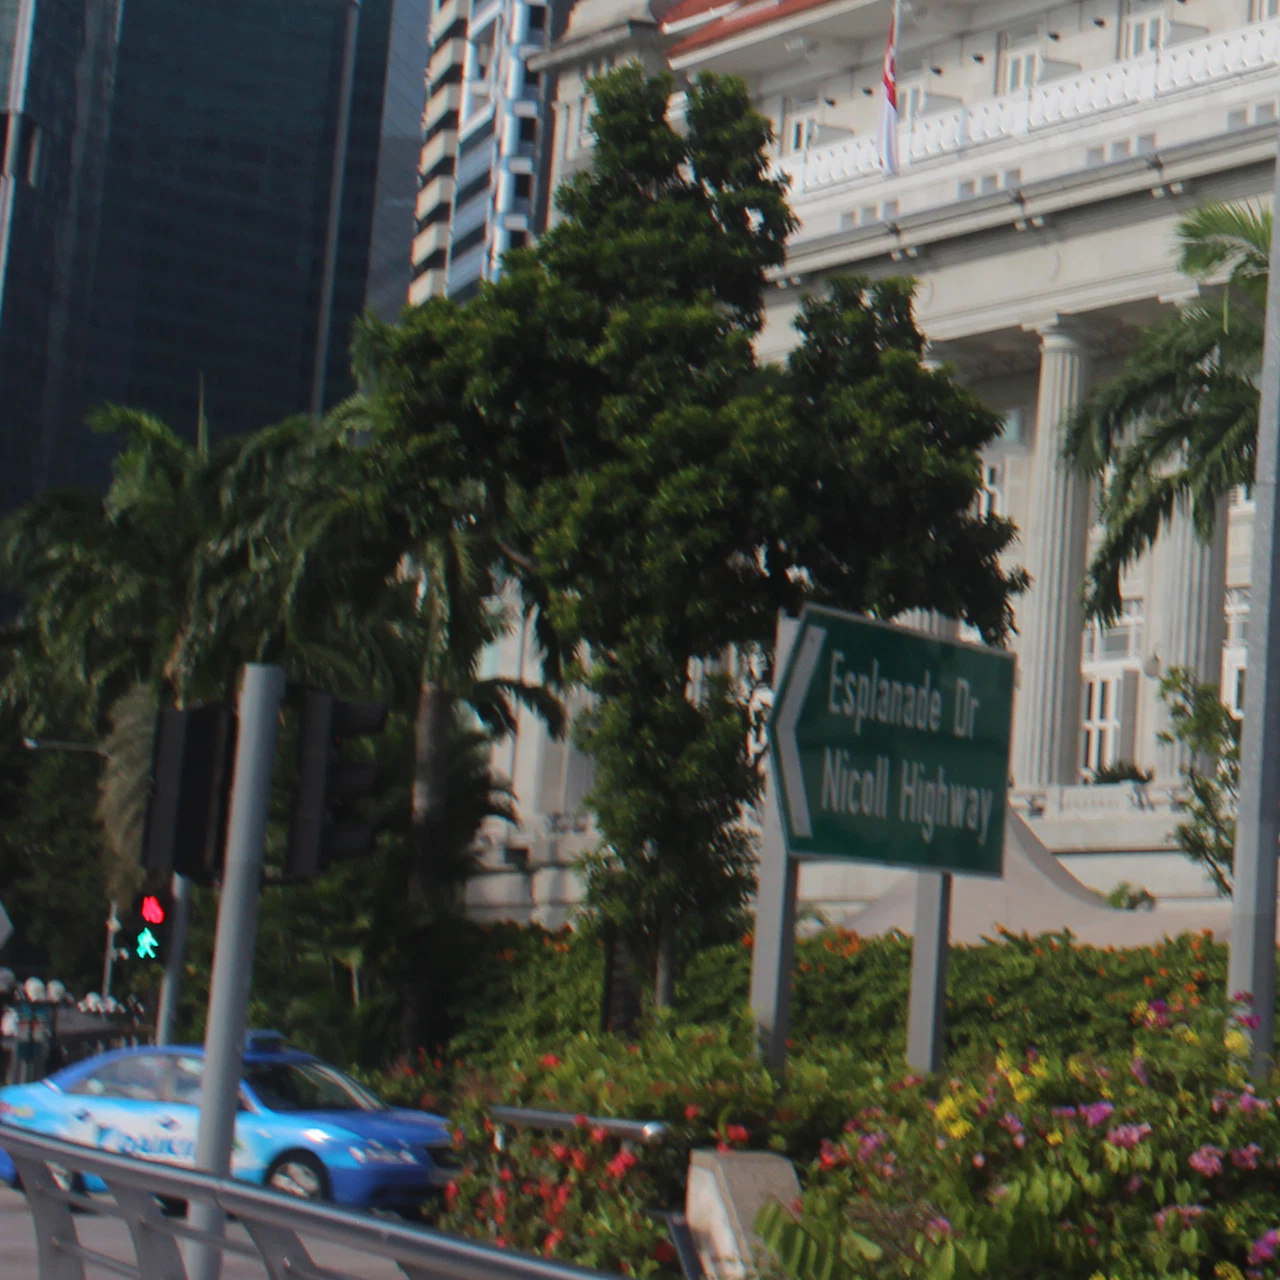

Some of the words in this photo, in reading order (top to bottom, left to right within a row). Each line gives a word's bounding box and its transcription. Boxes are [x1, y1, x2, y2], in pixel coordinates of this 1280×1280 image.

[828, 649, 943, 736] Esplanade
[953, 676, 980, 740] Dr
[821, 745, 890, 820] Nicoll
[900, 758, 994, 847] Highway
